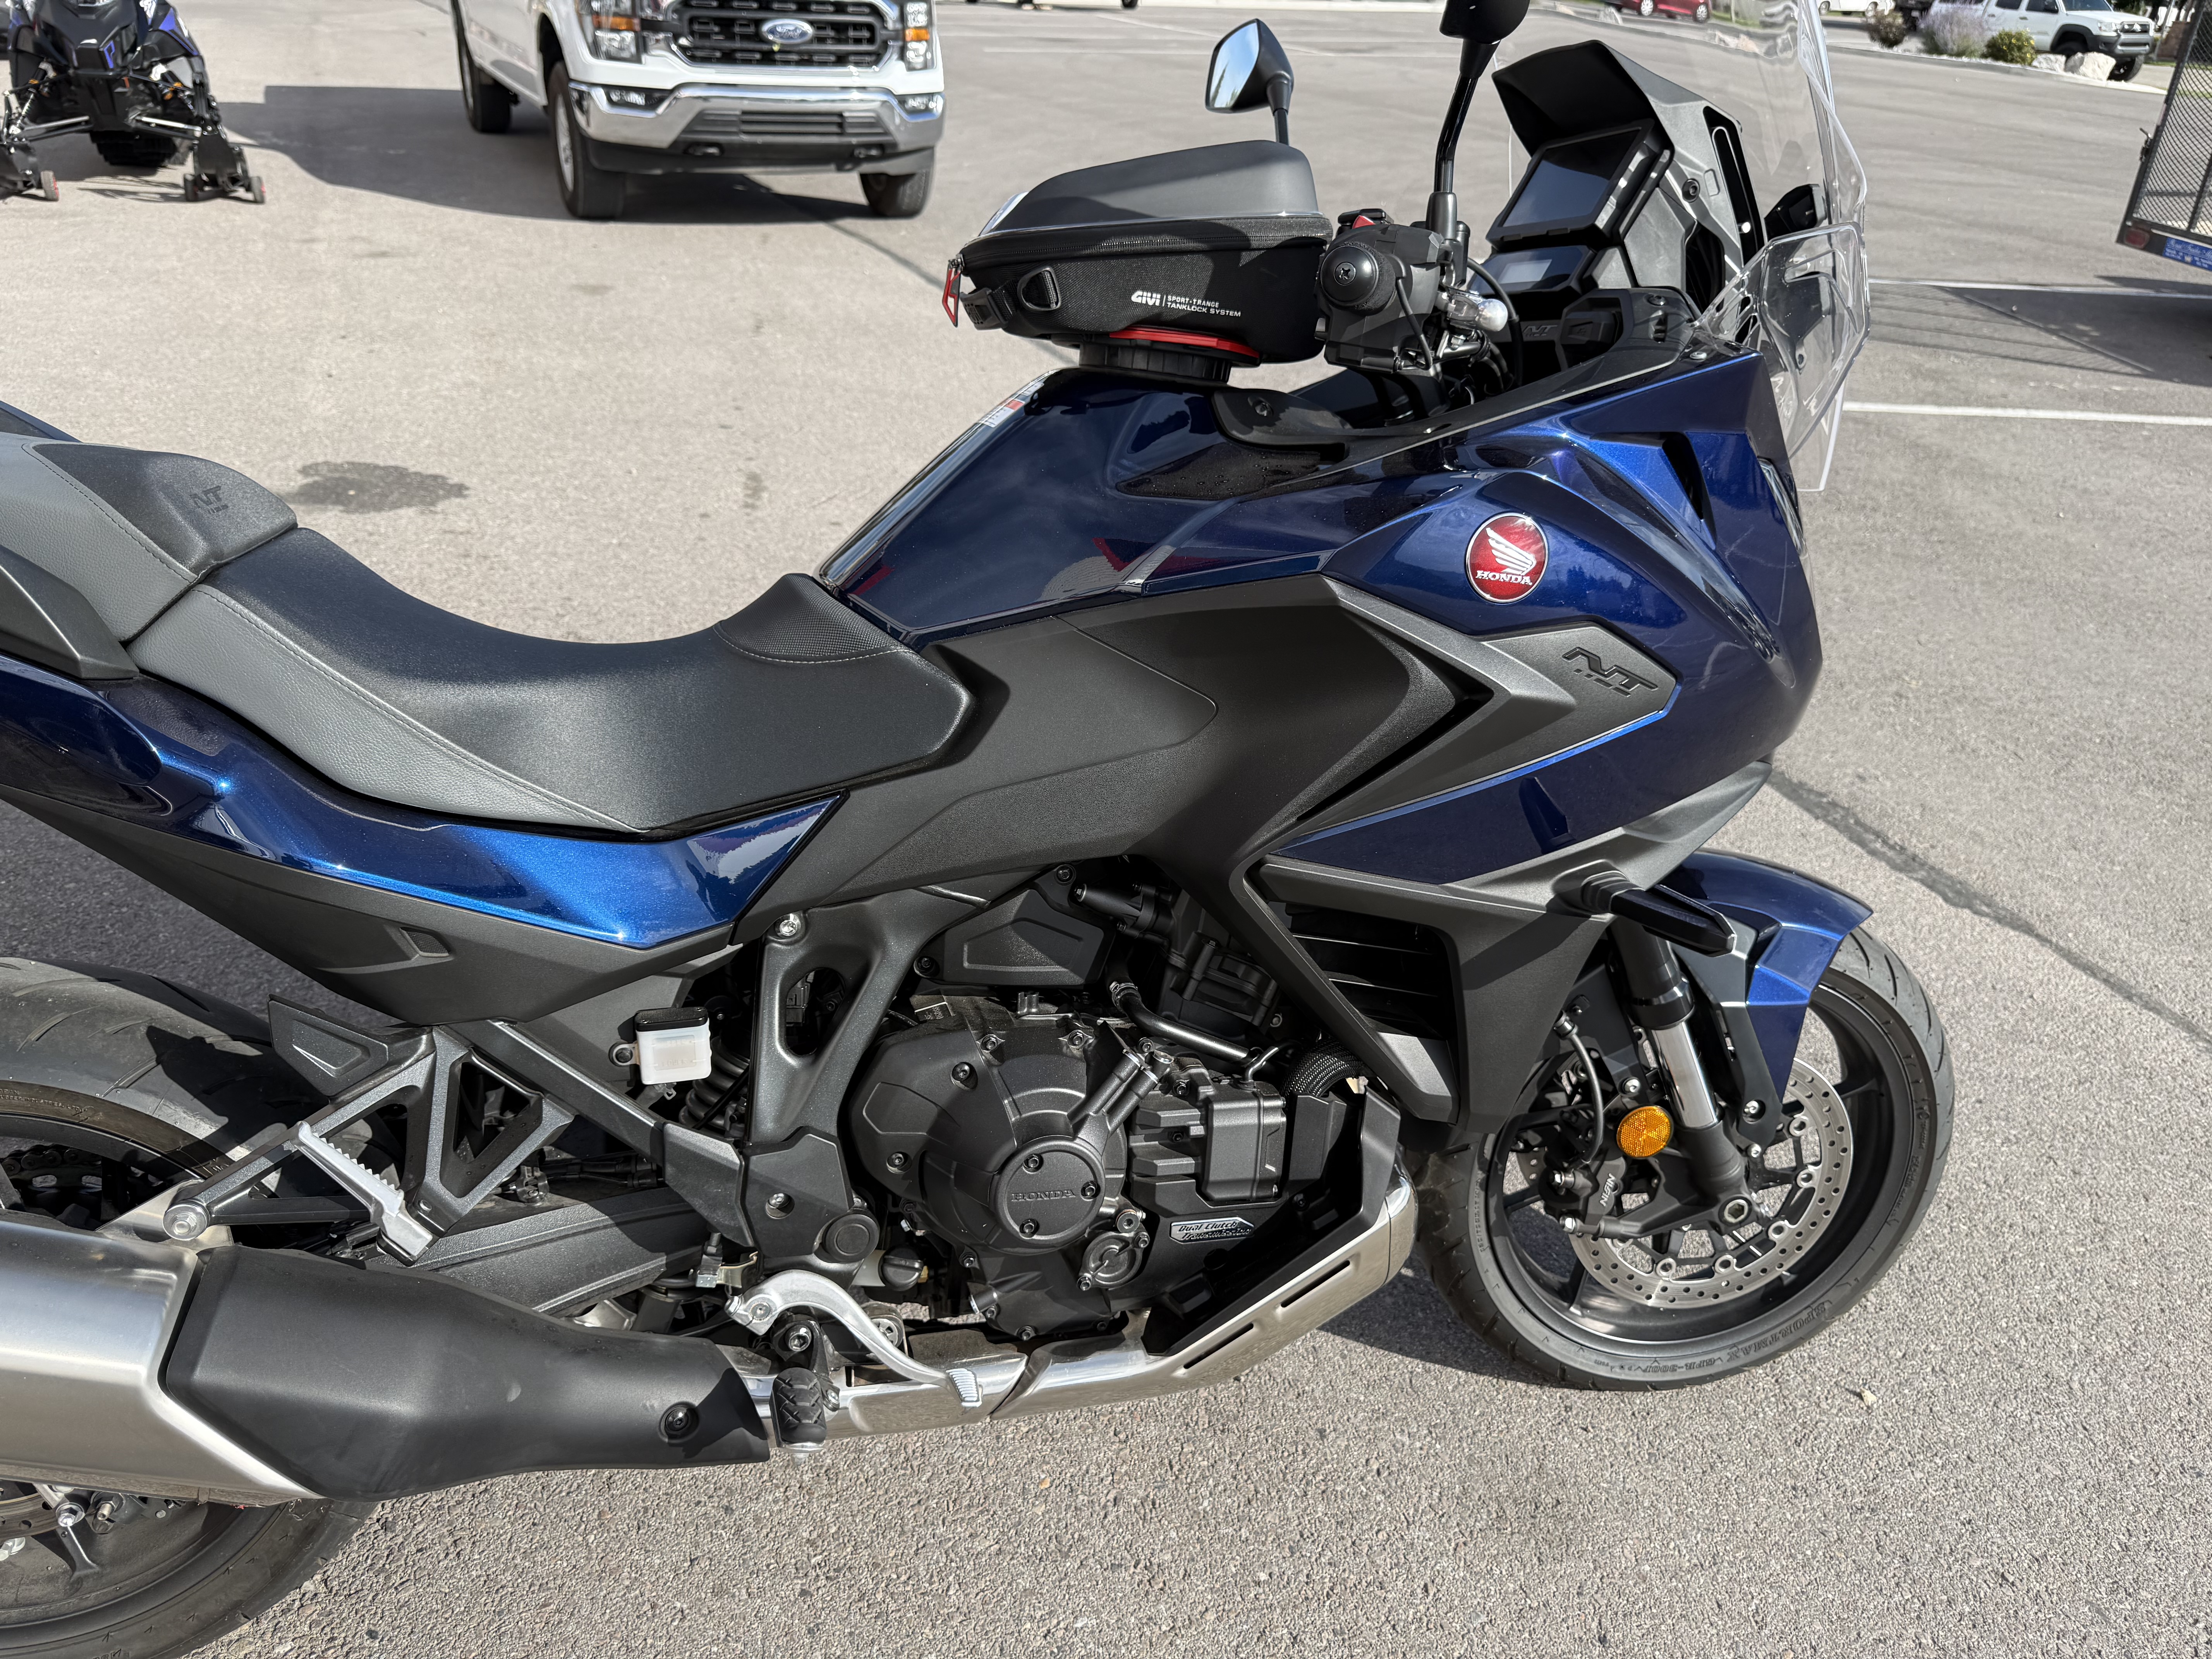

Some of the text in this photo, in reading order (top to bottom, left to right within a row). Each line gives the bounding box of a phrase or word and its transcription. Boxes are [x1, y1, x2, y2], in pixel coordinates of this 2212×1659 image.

[1131, 291, 1161, 306] GIVI
[1167, 302, 1241, 317] TANKLOCK SYSTEM
[1475, 570, 1533, 586] HONDA
[1561, 646, 1659, 691] NT
[1011, 1189, 1076, 1201] HONDA
[1600, 1173, 1615, 1206] NISSIN
[1178, 1221, 1238, 1233] Dual Clutch
